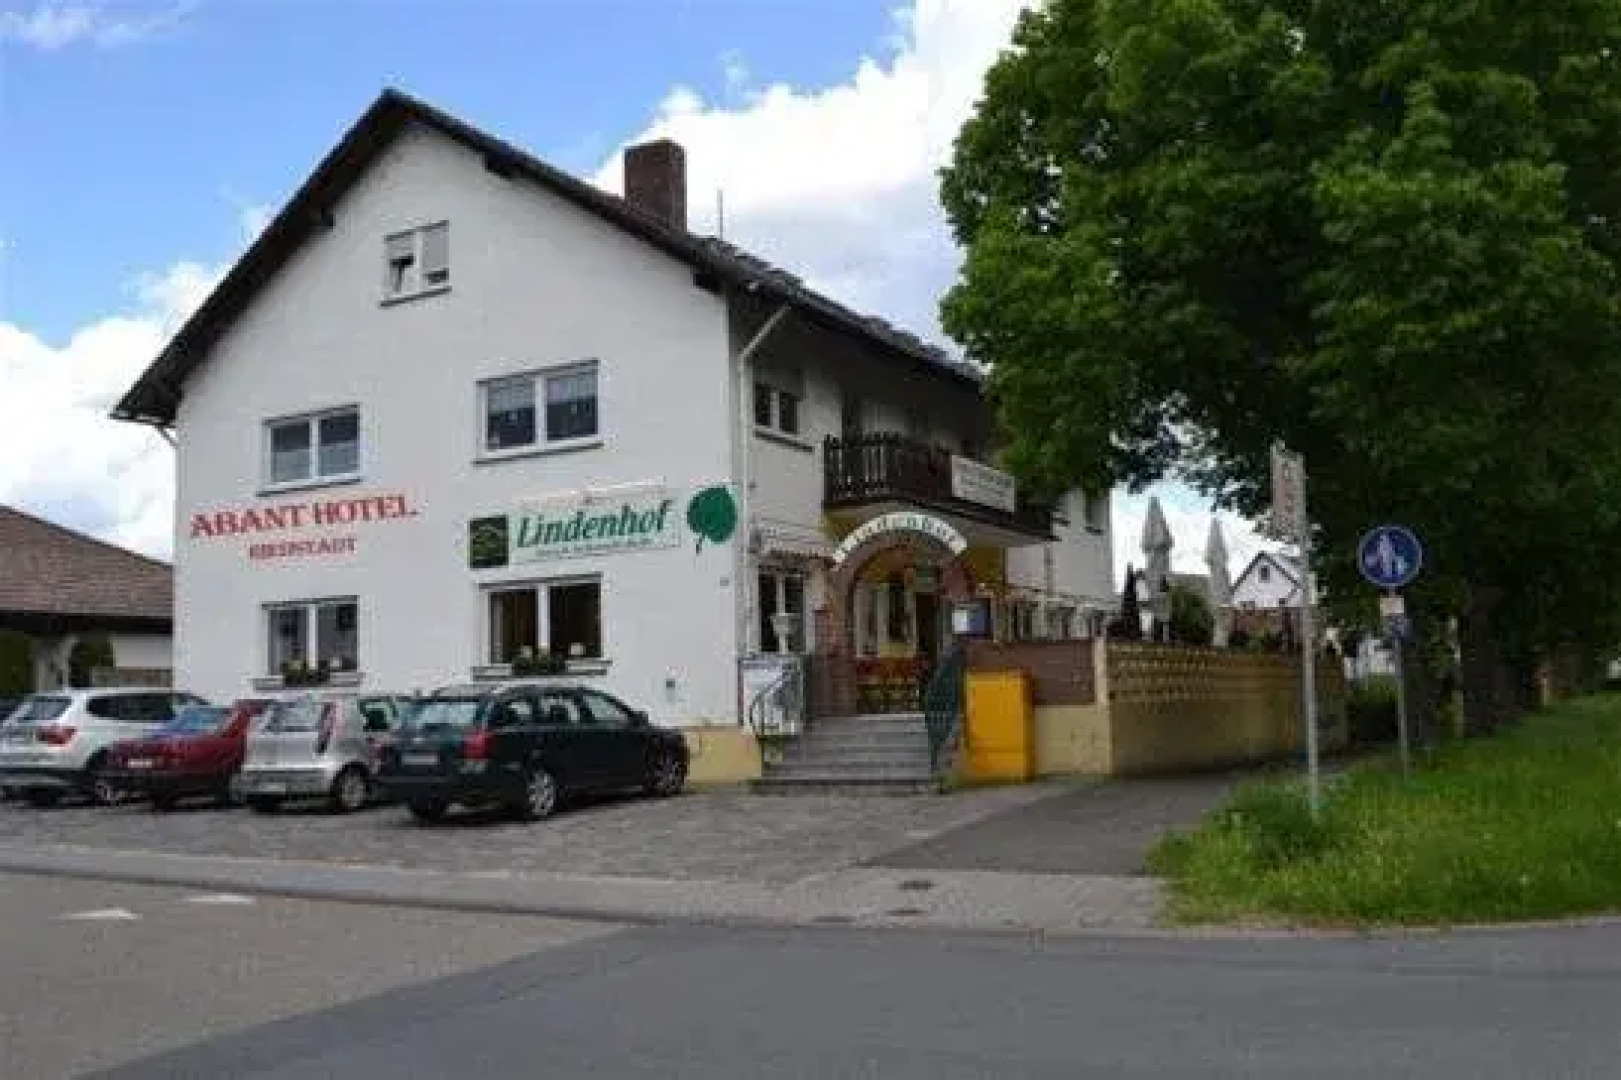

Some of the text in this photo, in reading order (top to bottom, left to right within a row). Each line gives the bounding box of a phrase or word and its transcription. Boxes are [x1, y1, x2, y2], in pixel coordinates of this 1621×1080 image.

[190, 494, 419, 537] ABANT HOTEL
[517, 497, 674, 548] Lindenhof
